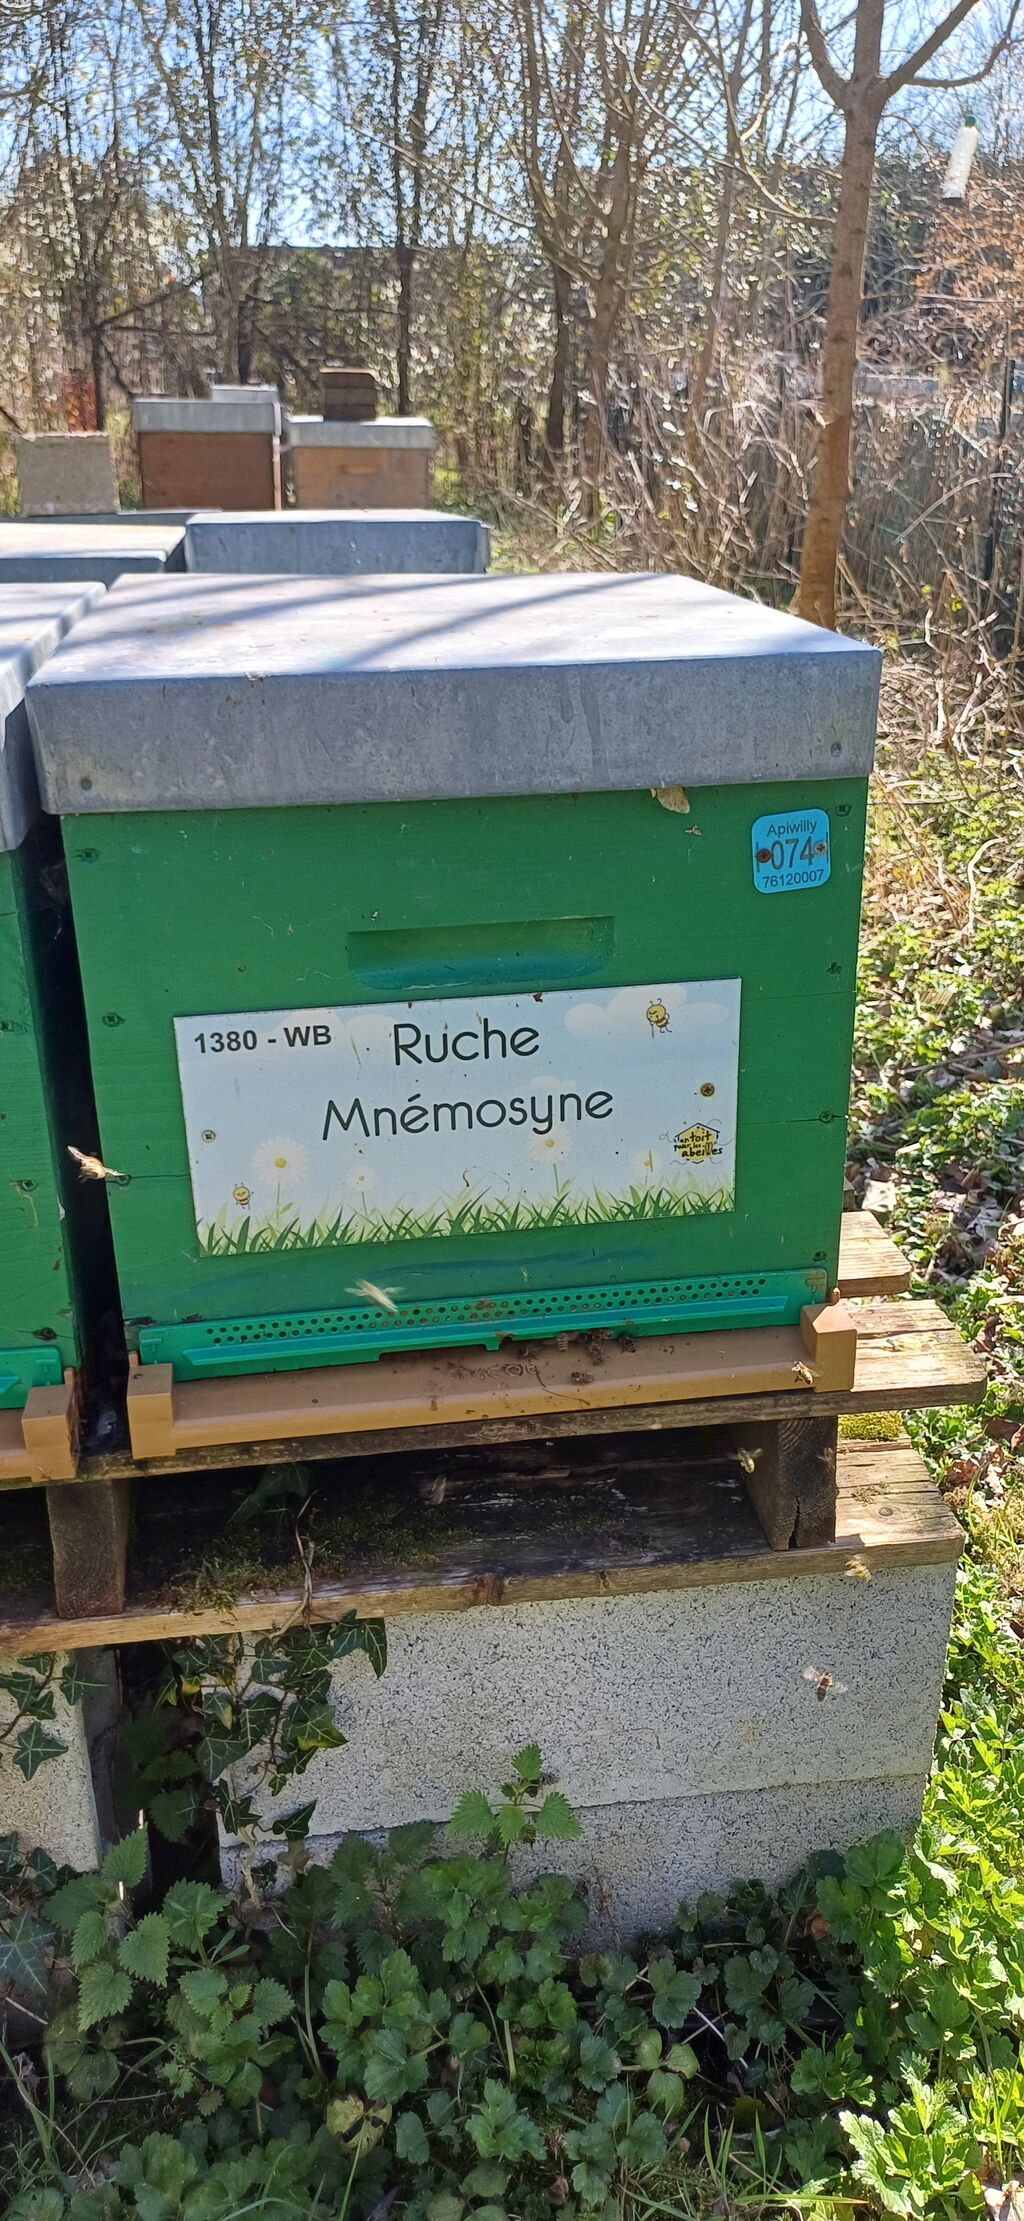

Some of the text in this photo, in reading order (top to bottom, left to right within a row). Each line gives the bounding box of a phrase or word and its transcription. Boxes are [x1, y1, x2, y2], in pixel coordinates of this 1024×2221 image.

[767, 819, 817, 838] Apiwilly
[771, 835, 815, 870] 074
[762, 869, 824, 889] 76120007
[194, 1029, 258, 1054] 1380
[283, 1024, 332, 1048] WB
[393, 1017, 540, 1066] Ruche
[322, 1091, 614, 1141] Mnémosyne
[689, 1130, 712, 1143] toit
